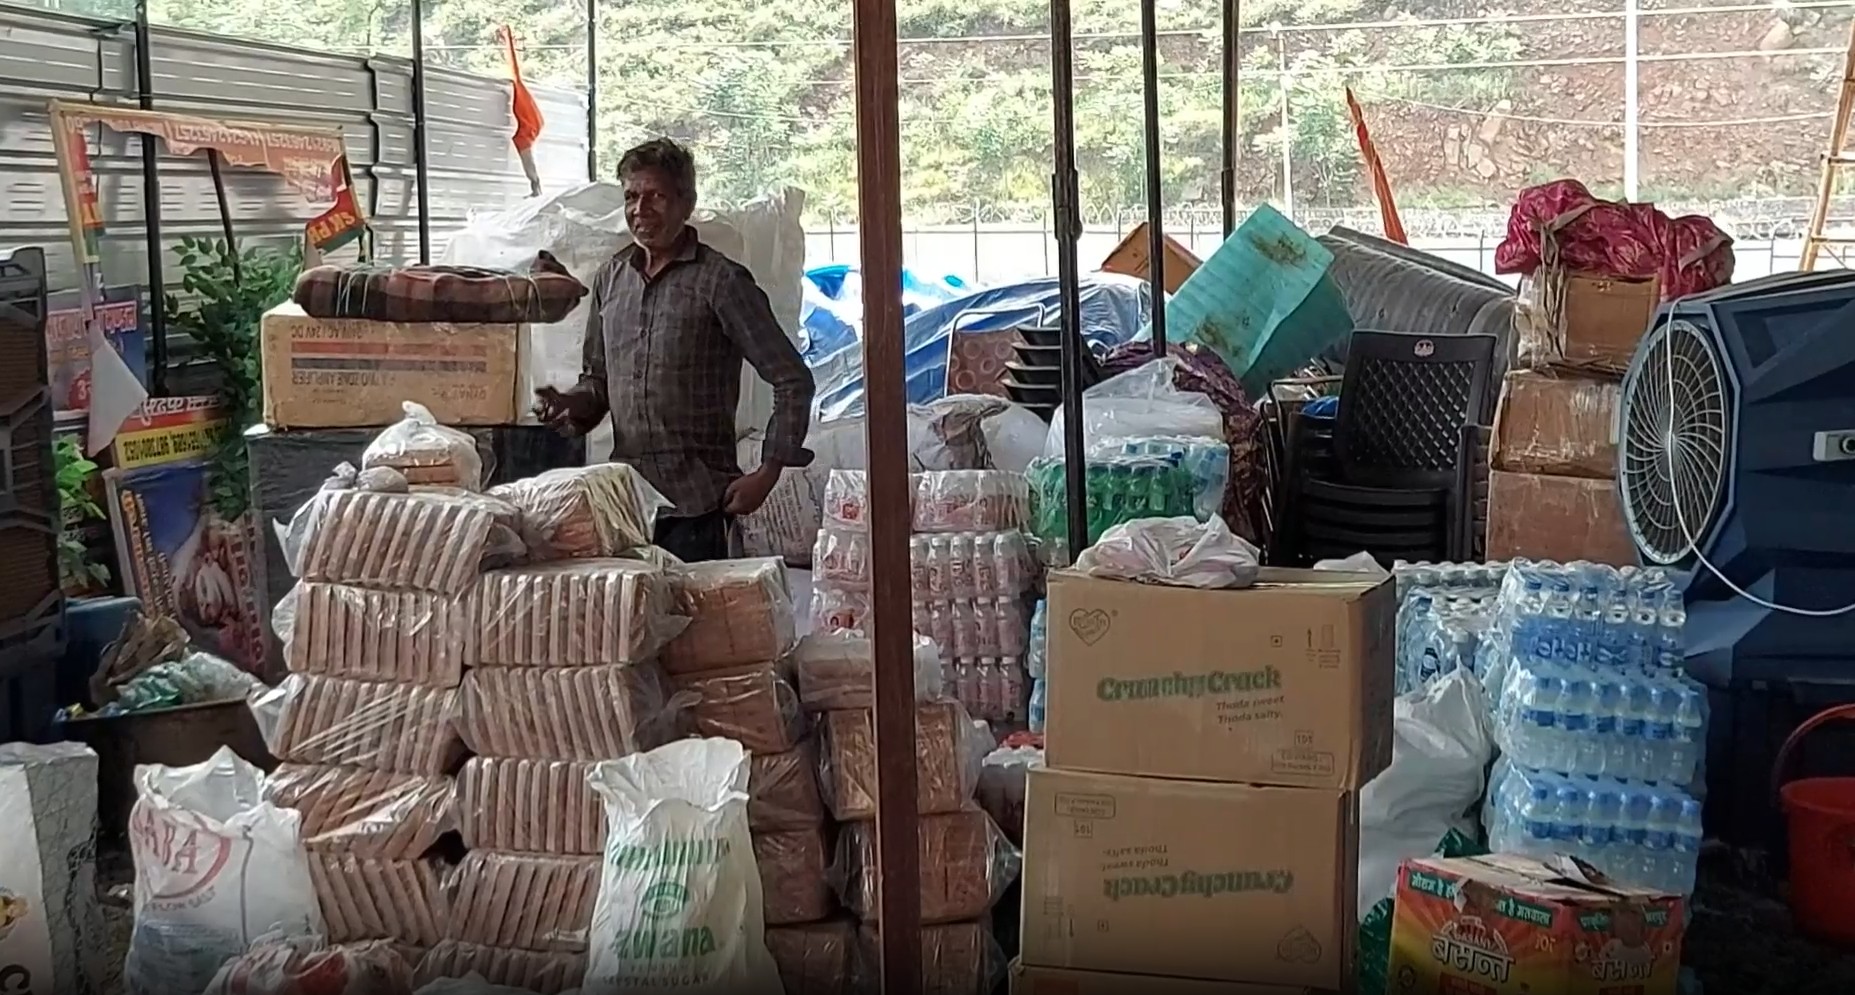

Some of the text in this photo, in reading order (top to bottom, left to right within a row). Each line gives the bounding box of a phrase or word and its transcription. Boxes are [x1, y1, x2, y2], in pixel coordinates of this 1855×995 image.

[1096, 664, 1282, 701] CrunchyCrack
[1216, 700, 1249, 711] Thoda
[1217, 713, 1251, 725] Thoda
[1103, 869, 1294, 903] CrunchyCrack
[610, 925, 716, 959] awana
